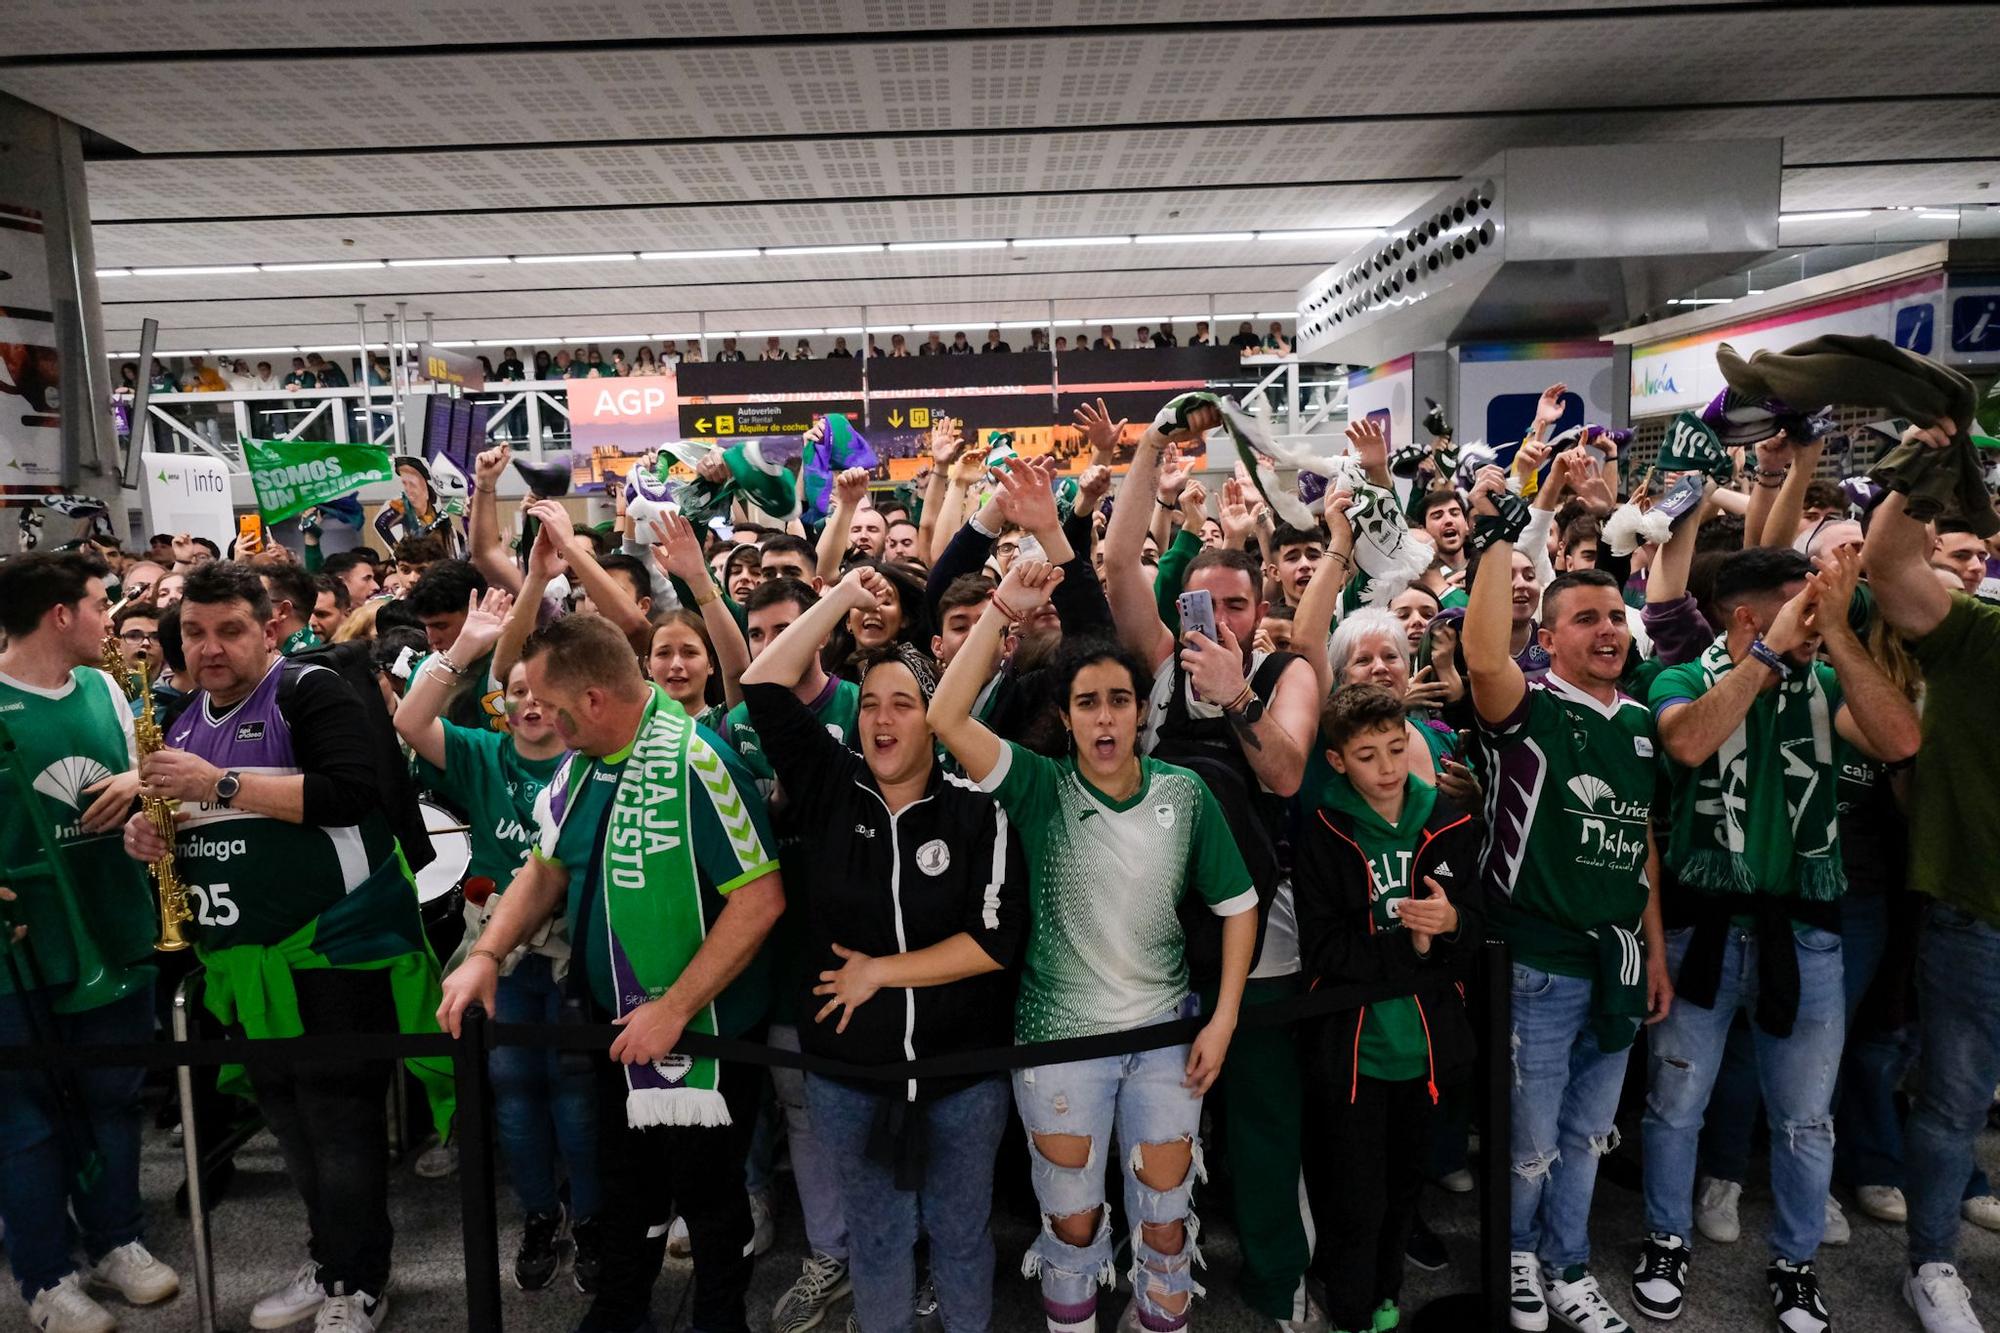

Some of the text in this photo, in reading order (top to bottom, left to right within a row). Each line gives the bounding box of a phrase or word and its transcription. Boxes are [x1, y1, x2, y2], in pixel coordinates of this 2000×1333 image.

[593, 388, 664, 417] AGP
[738, 407, 782, 416] Autoverleih
[931, 409, 945, 417] Exit
[739, 423, 809, 435] Alquiler de coches
[194, 469, 224, 493] info
[254, 456, 343, 490] SOMOS
[260, 487, 296, 511] UN
[644, 709, 686, 855] UNICAJA
[1842, 763, 1875, 782] caja
[189, 882, 240, 927] 25
